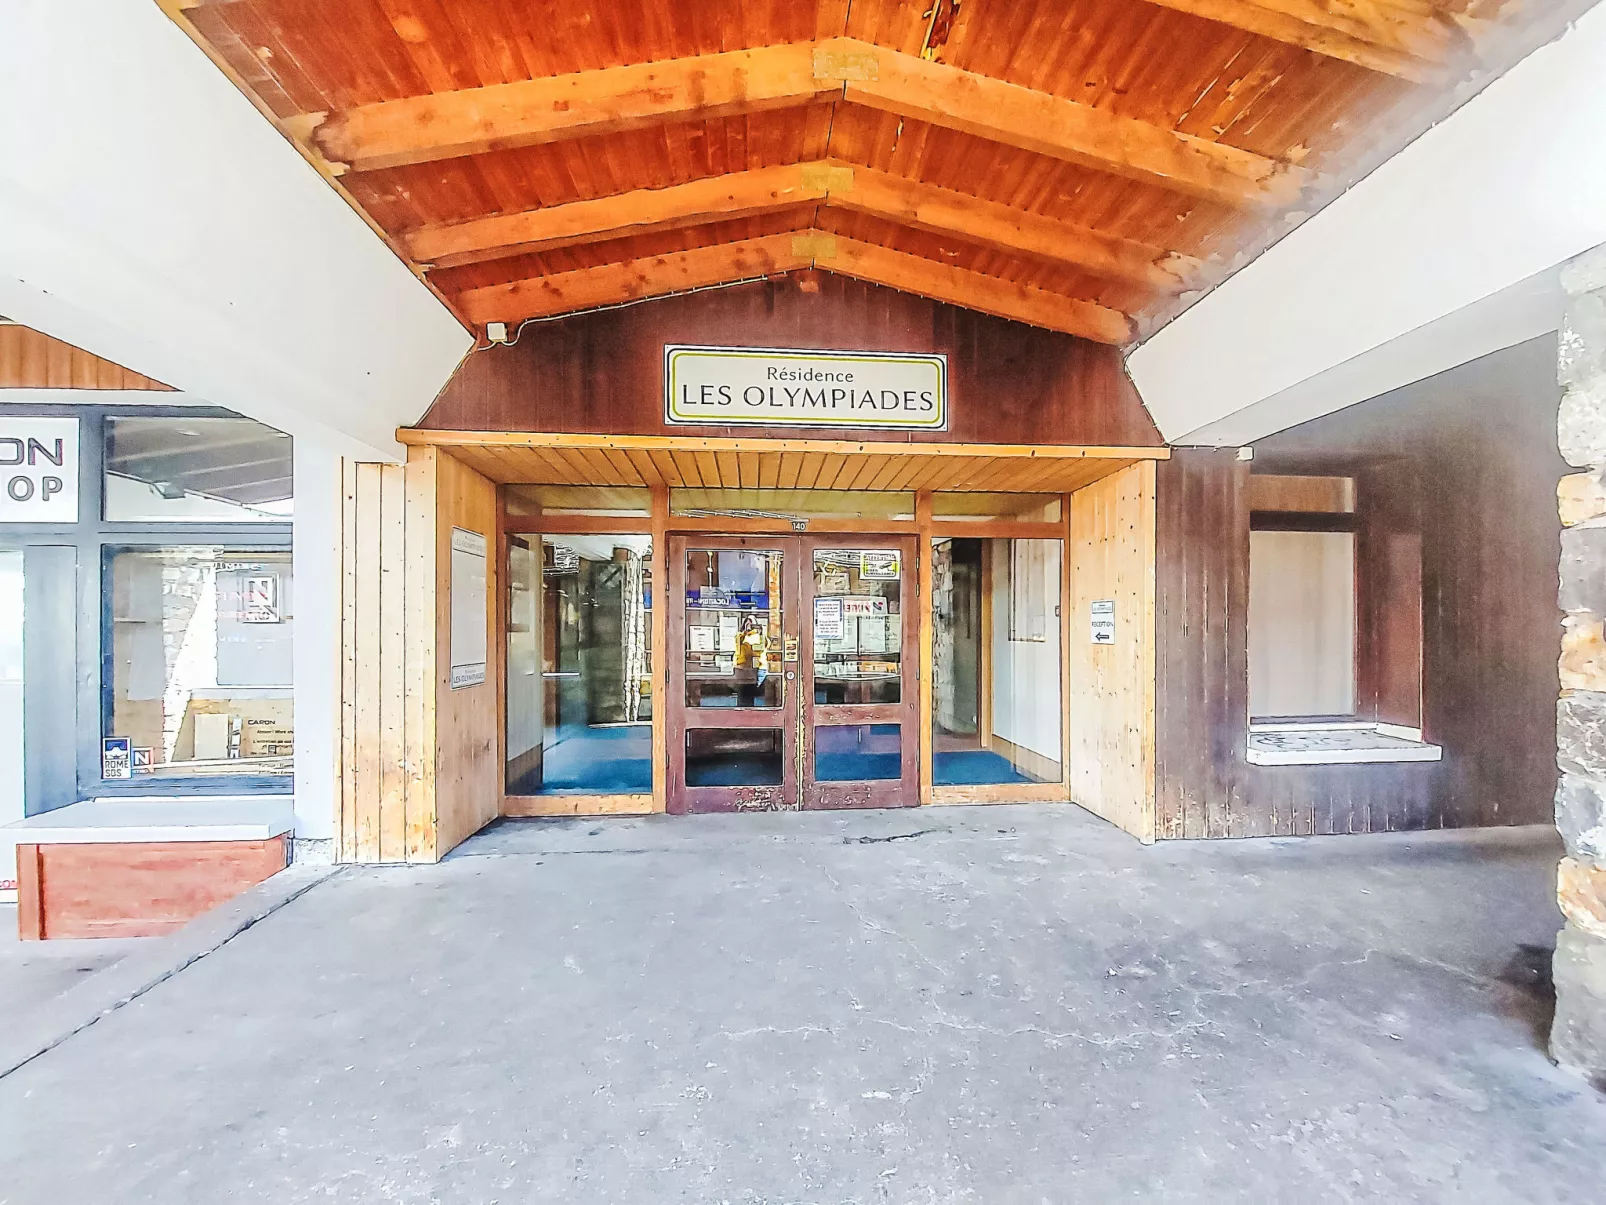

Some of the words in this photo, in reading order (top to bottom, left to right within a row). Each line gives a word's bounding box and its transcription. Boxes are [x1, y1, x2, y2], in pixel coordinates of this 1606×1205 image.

[767, 366, 854, 383] Résidence
[683, 384, 732, 406] LES
[743, 386, 933, 411] OLYMPIADES
[792, 522, 806, 531] 140
[105, 760, 129, 769] ROME
